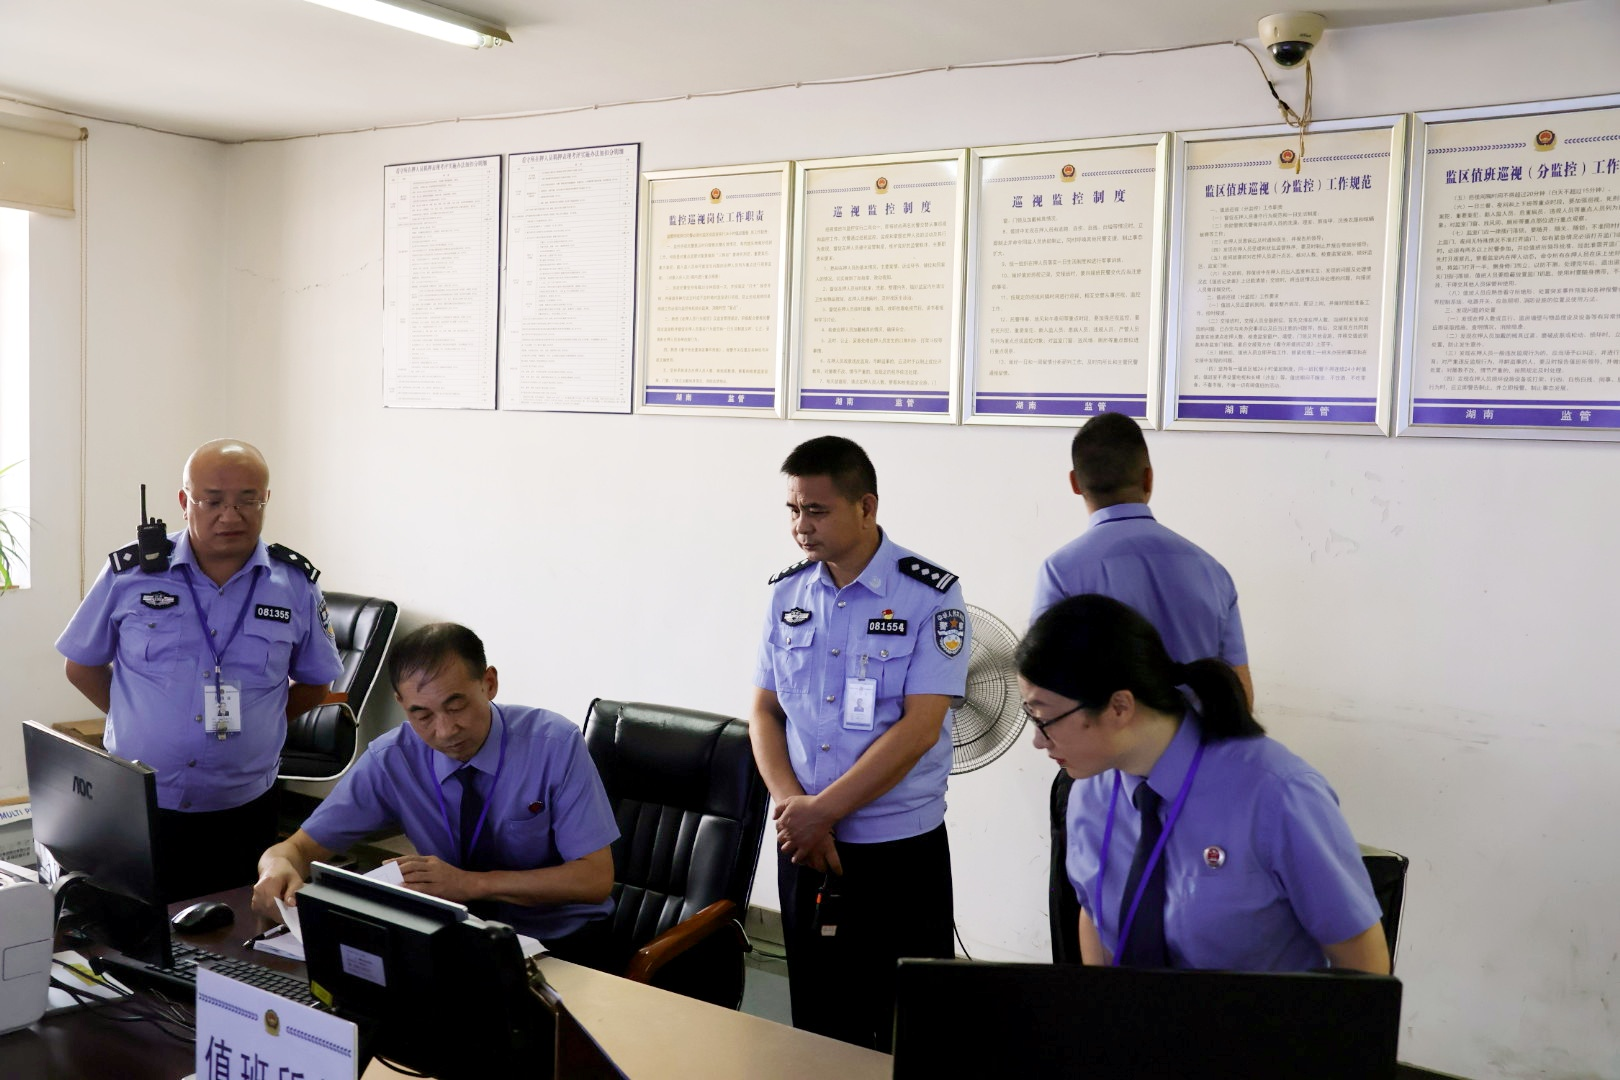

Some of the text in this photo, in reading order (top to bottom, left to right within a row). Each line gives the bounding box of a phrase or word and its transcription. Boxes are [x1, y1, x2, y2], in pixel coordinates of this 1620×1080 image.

[1205, 174, 1372, 198] 监区值班巡视（分监控）工作规范
[1012, 189, 1126, 208] 巡视监控制度
[833, 200, 931, 217] 巡视监控制度
[669, 210, 764, 226] 监控巡视岗位工作职责
[728, 395, 745, 403] 监管
[835, 397, 914, 407] 湖南 监管
[1015, 401, 1106, 411] 湖南 监管
[1224, 405, 1330, 416] 湖南 监管
[1465, 409, 1592, 421] 湖南 监管
[257, 607, 290, 620] 081355
[869, 621, 905, 632] 081554
[72, 775, 93, 800] AOC
[205, 1035, 324, 1080] 值班
